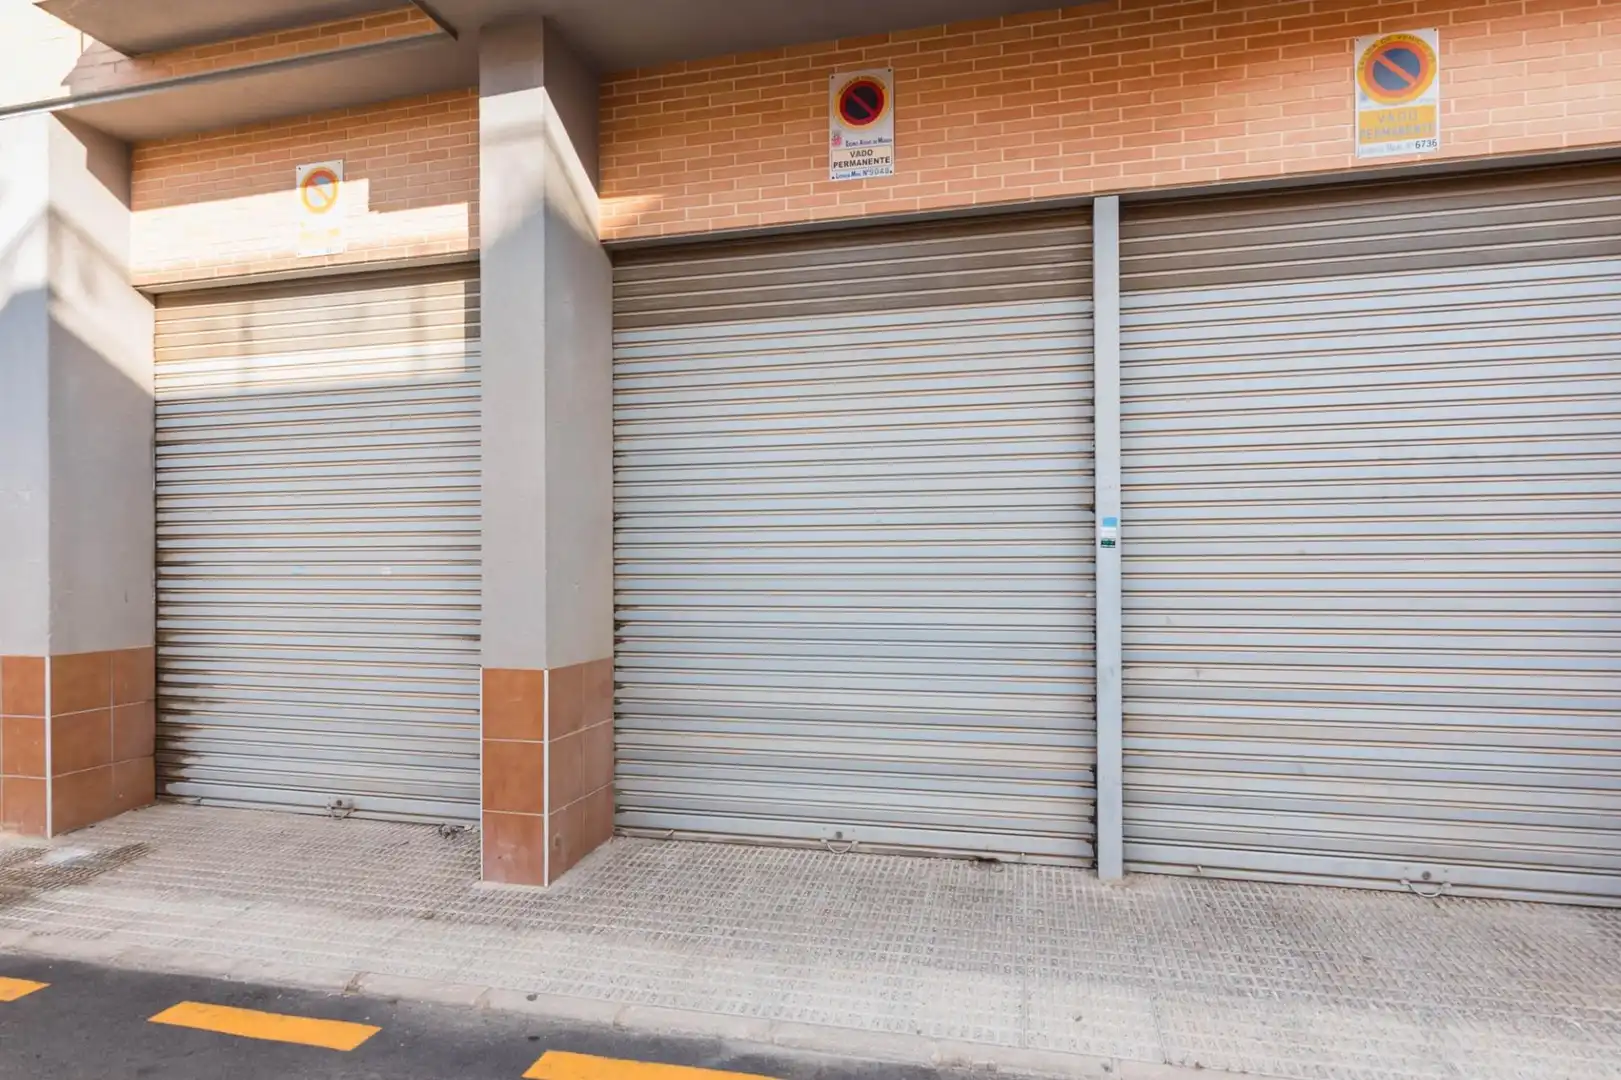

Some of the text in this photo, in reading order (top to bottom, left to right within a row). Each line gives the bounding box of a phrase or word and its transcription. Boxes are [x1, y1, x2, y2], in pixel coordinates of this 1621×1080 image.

[1415, 139, 1438, 149] 6736
[849, 149, 873, 158] VADO
[833, 156, 891, 168] PERMANENTE
